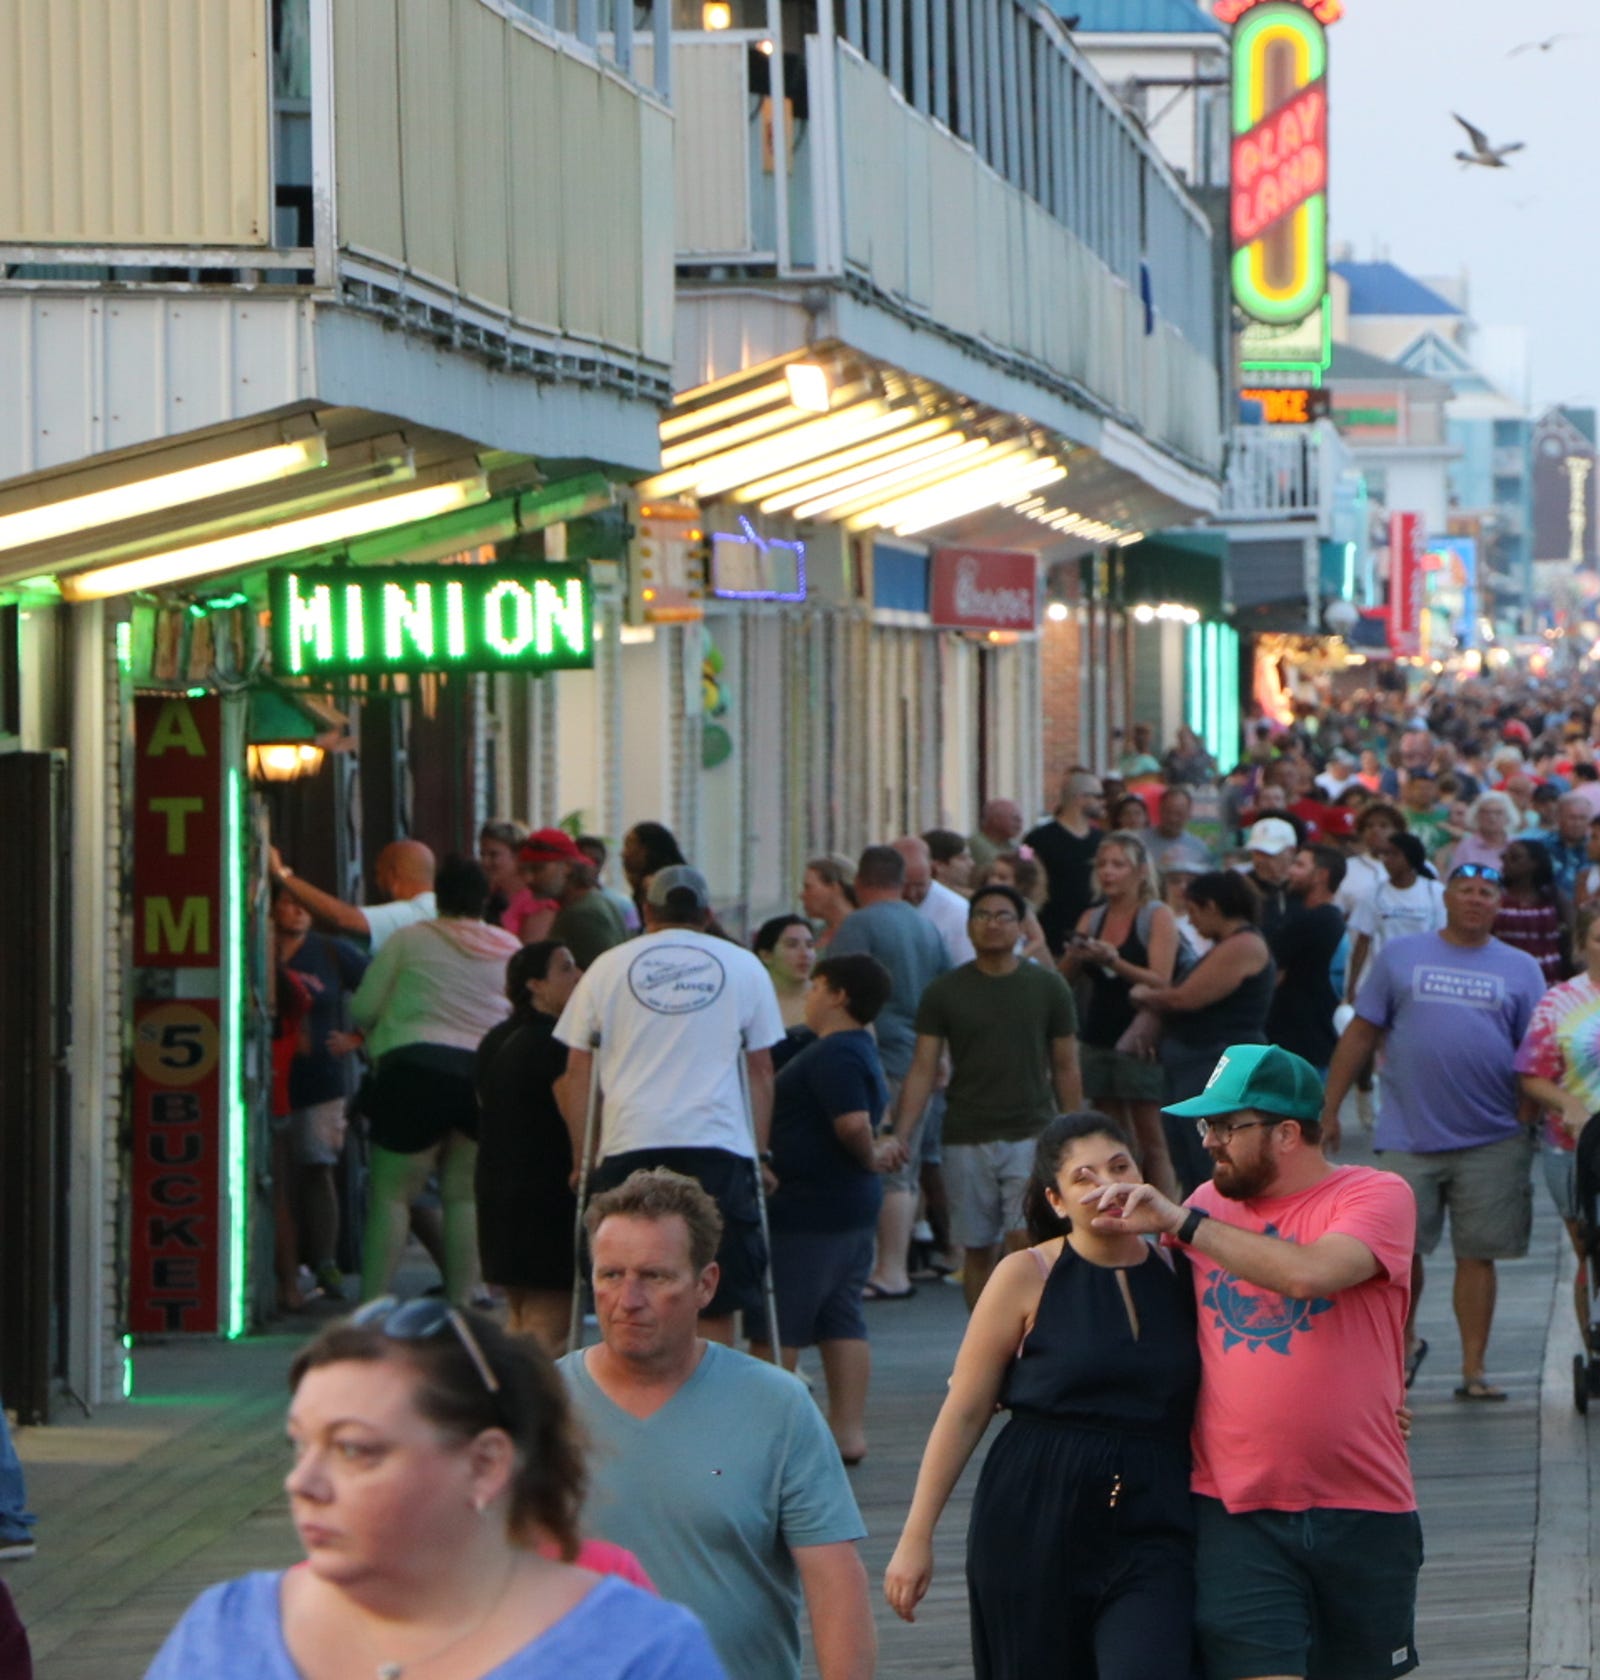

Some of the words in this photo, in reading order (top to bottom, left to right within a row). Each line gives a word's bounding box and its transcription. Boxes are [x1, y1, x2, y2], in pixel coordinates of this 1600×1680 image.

[1236, 91, 1319, 188] PLAY
[1236, 145, 1321, 237] LAND
[289, 573, 586, 675] MINION
[143, 703, 211, 954] ATM
[1424, 982, 1465, 996] EAGLE
[1467, 987, 1492, 999] USA
[1426, 973, 1493, 989] AMERICAN
[147, 1092, 203, 1332] BUCKET
